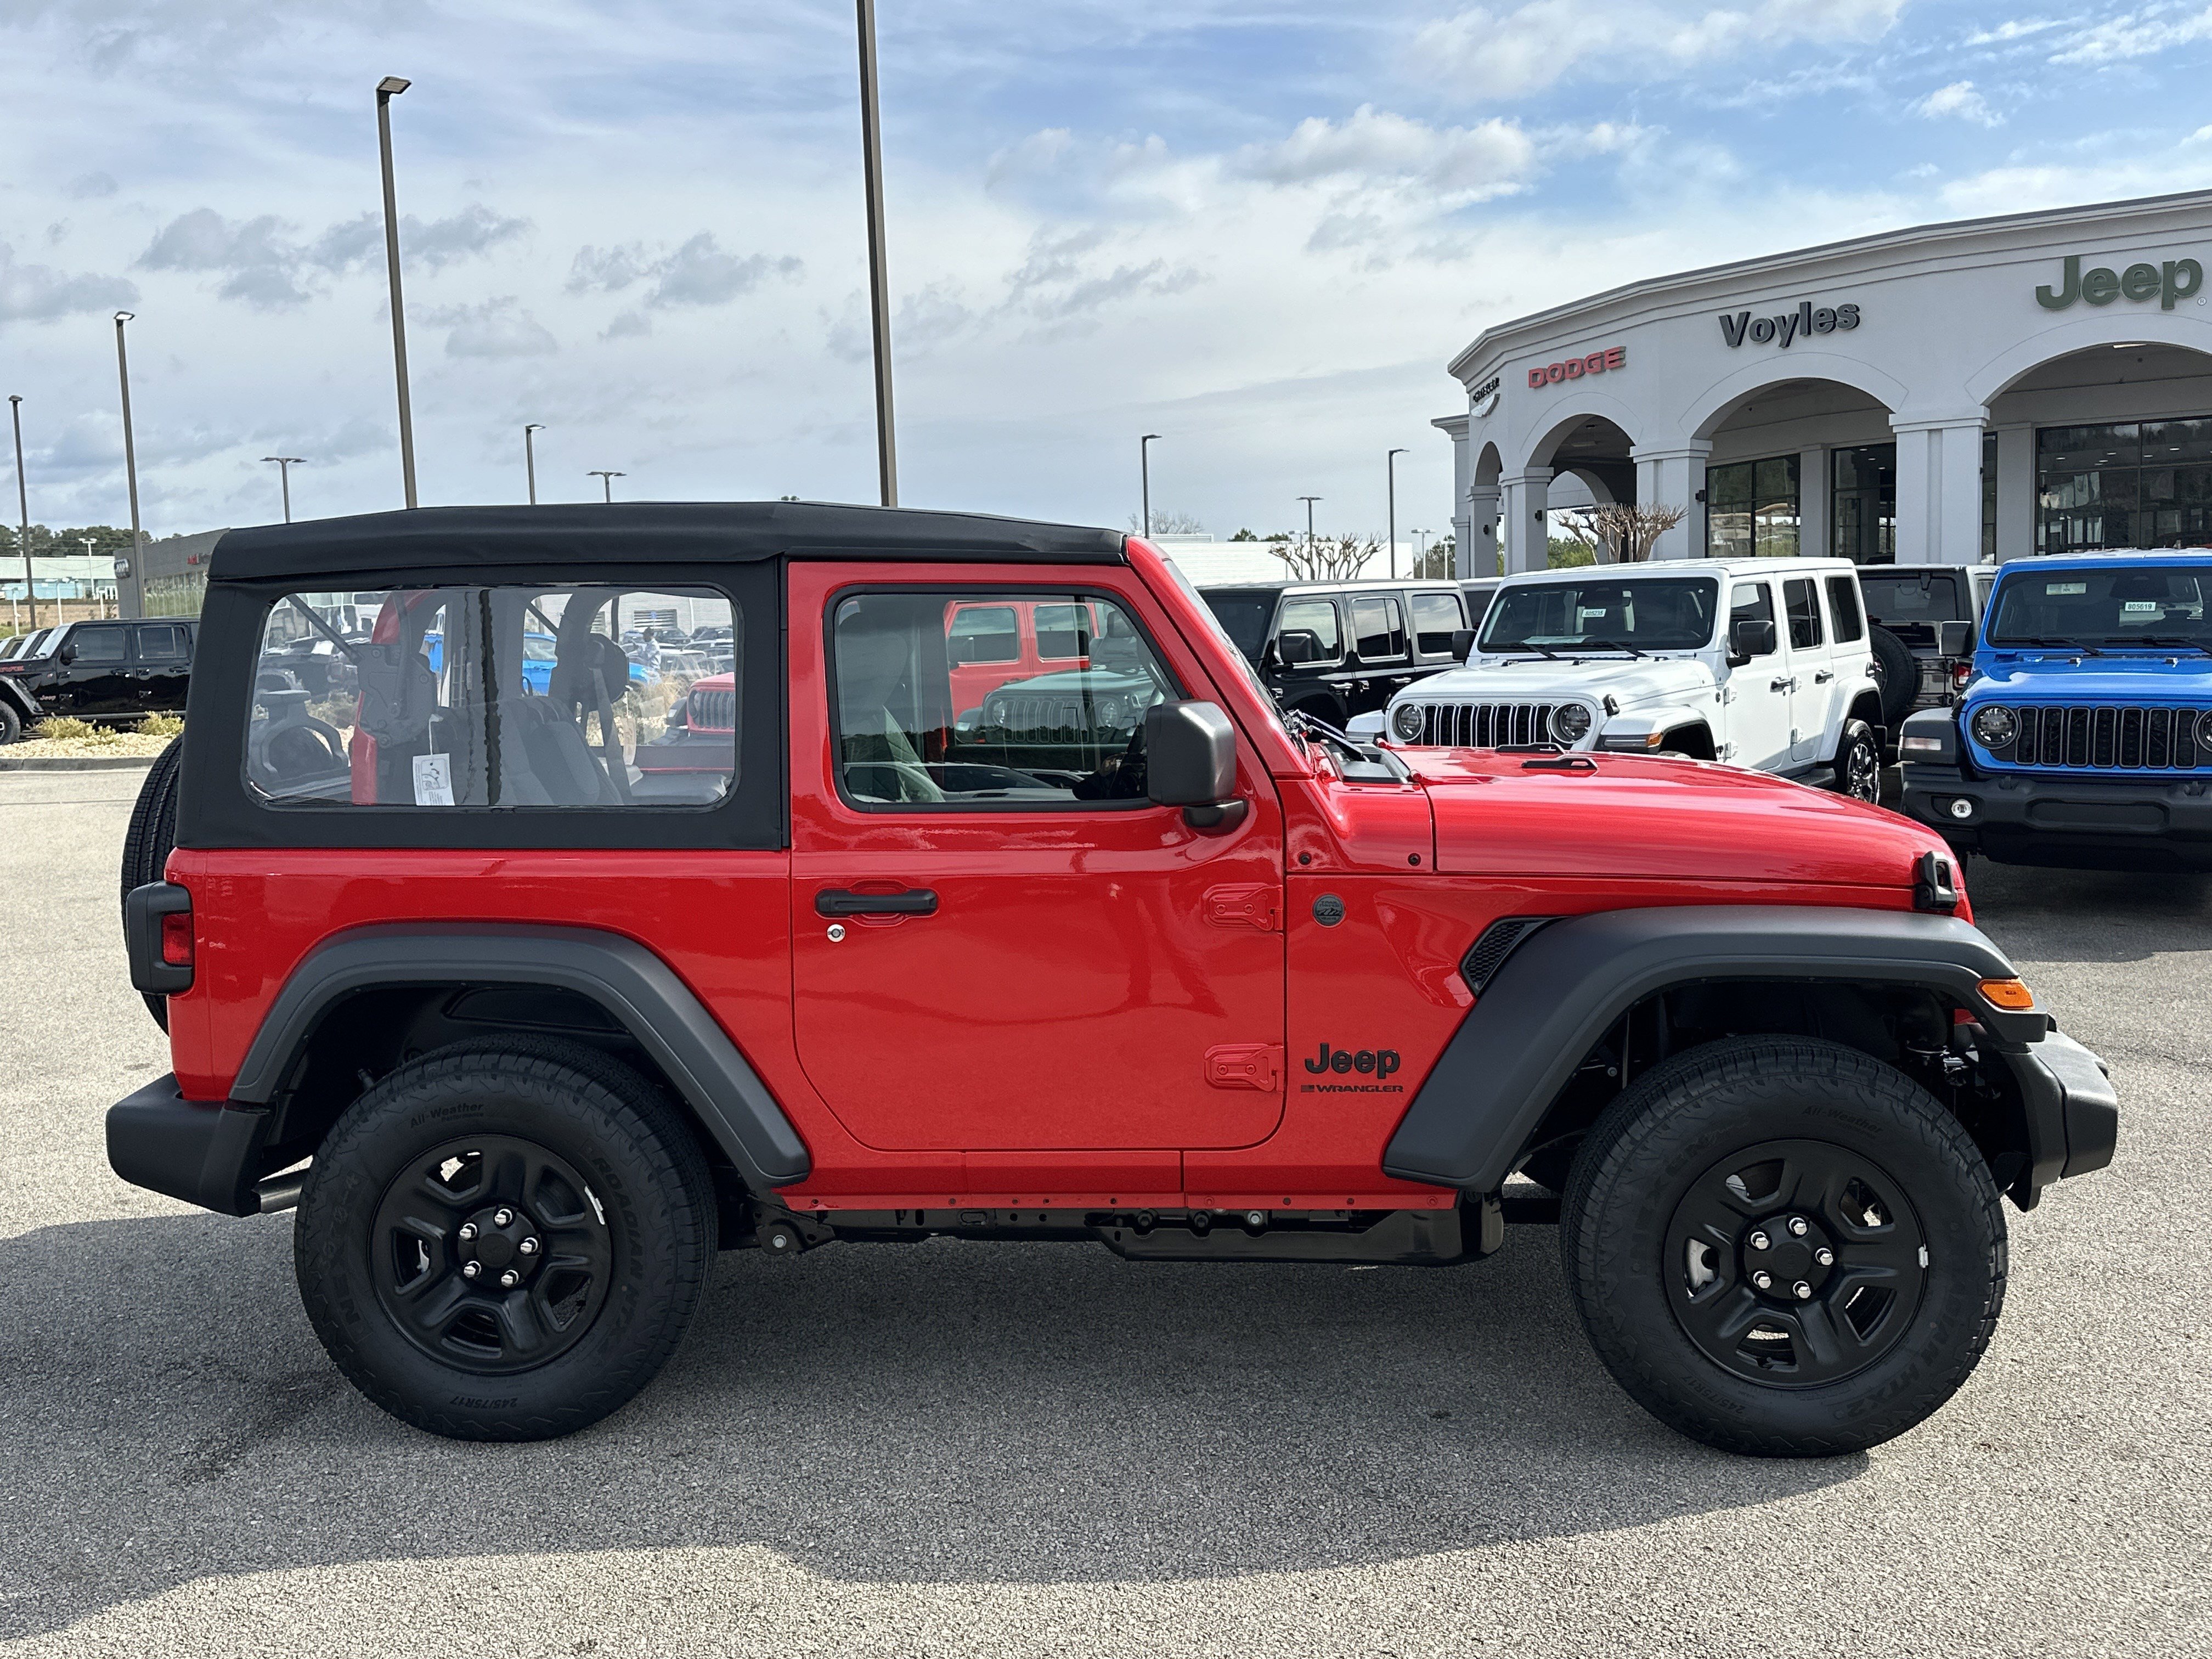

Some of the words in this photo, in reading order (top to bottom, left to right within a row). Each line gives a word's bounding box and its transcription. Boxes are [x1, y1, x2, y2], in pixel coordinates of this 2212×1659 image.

[2035, 255, 2203, 310] Jeep
[1718, 301, 1860, 348] Voyles
[1528, 346, 1627, 389] DODGE
[1305, 1042, 1401, 1080] Jeep
[1316, 1085, 1404, 1093] WRANGLER
[411, 1103, 484, 1128] All-Weather
[1801, 1105, 1884, 1134] All-Weather
[449, 1395, 519, 1410] 245/75R17
